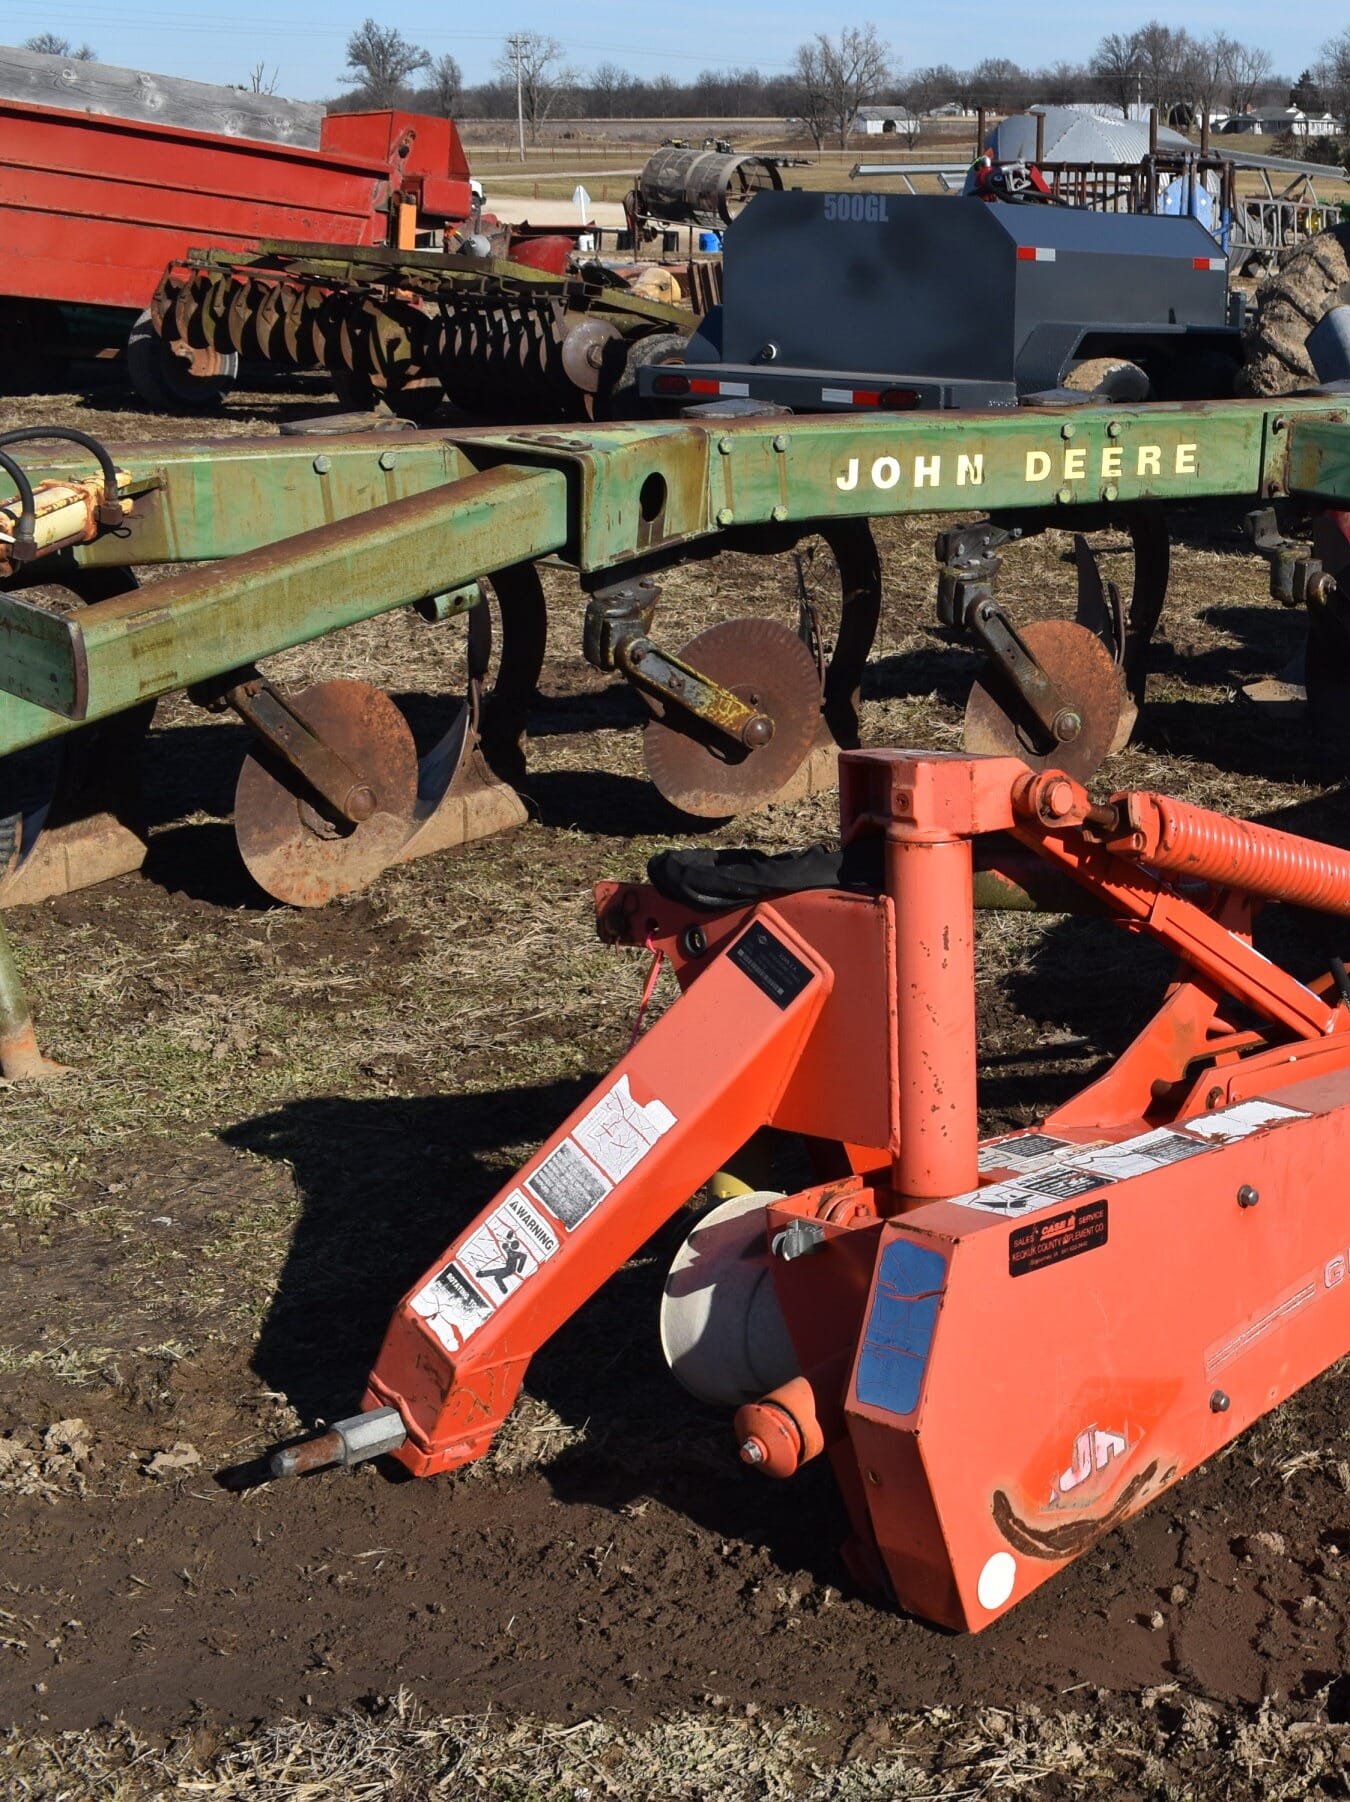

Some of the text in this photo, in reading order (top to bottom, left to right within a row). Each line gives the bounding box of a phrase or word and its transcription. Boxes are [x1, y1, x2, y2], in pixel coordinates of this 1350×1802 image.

[824, 194, 889, 222] 500GL
[836, 443, 1198, 491] JOHN DEERE
[515, 1205, 555, 1251] WARNING
[1014, 1233, 1035, 1248] SALES
[1041, 1219, 1067, 1236] CASE
[1079, 1210, 1105, 1225] SERVICE
